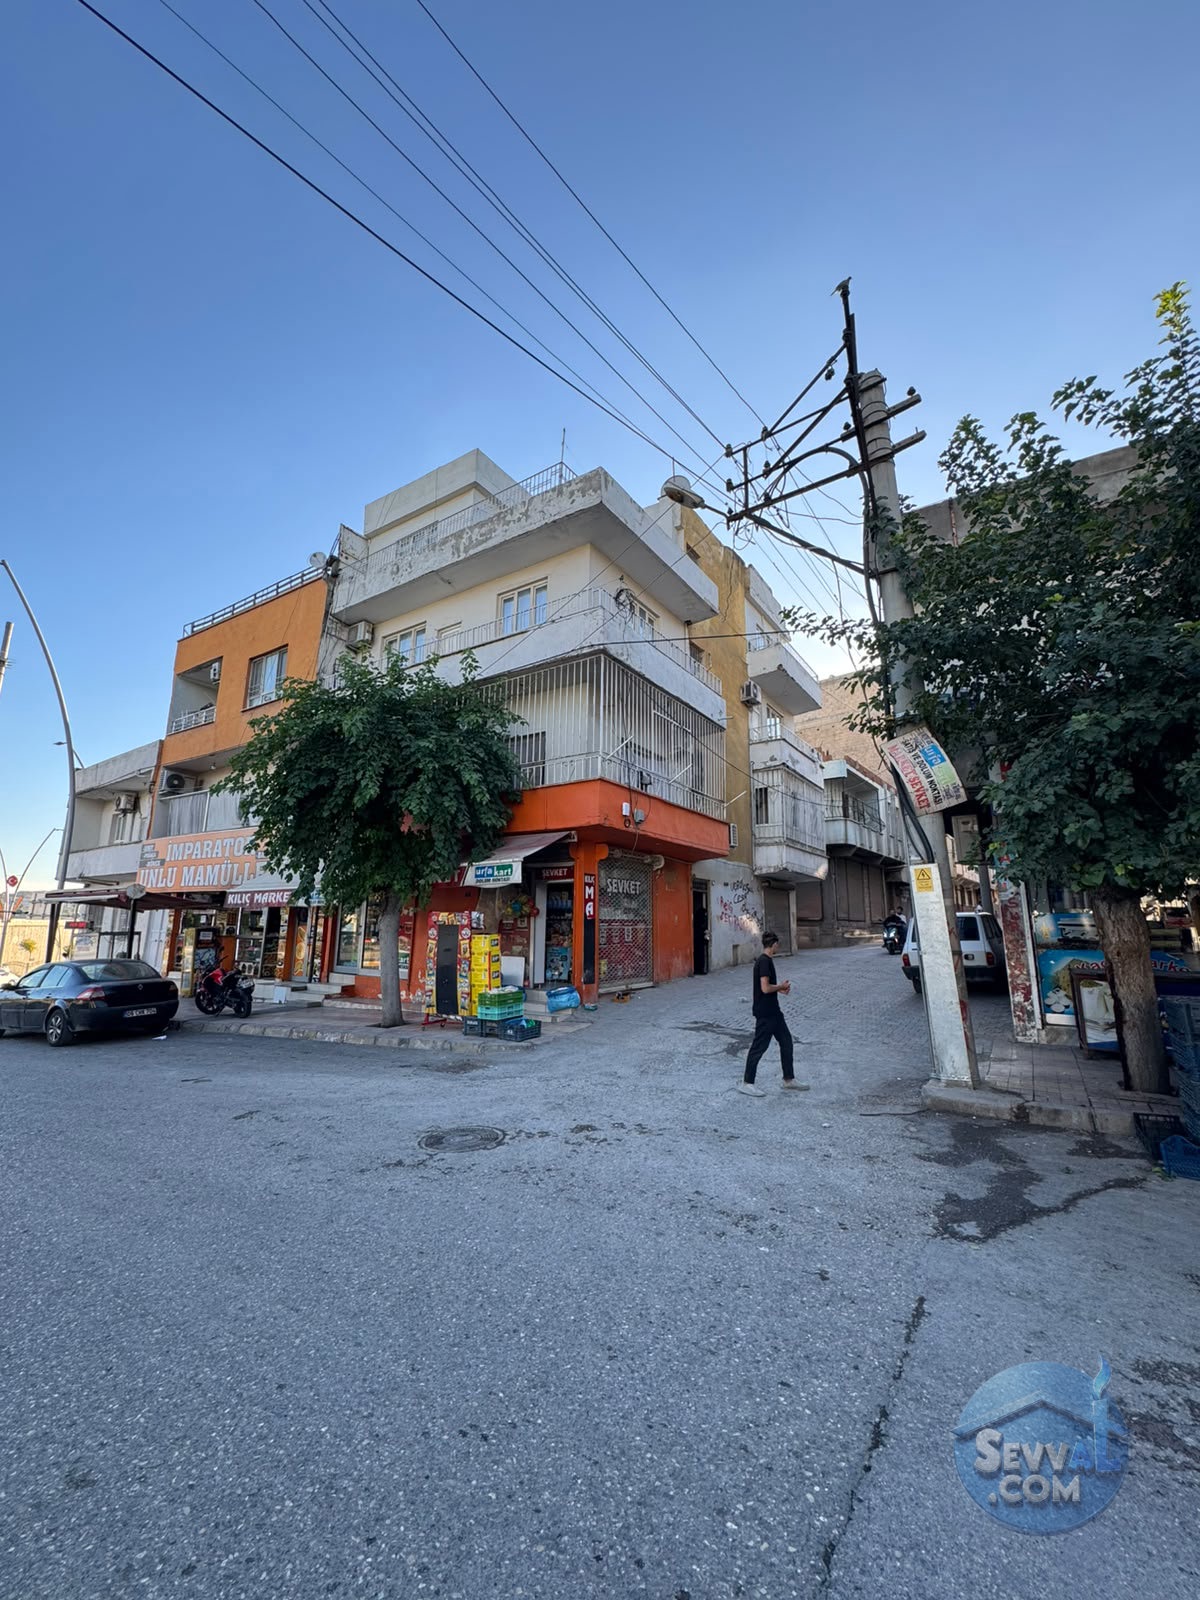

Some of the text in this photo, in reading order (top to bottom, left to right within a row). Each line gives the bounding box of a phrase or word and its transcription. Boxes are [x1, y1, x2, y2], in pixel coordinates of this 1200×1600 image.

[911, 749, 921, 761] VE
[915, 757, 933, 780] DOLUM
[927, 777, 943, 805] NOKTASI
[139, 866, 178, 889] UNLU
[475, 866, 493, 878] urfa
[493, 866, 512, 877] kart
[541, 868, 568, 880] ŞEVKET
[606, 878, 641, 897] ŞEVKET
[227, 891, 291, 906] KILIÇ MARKE
